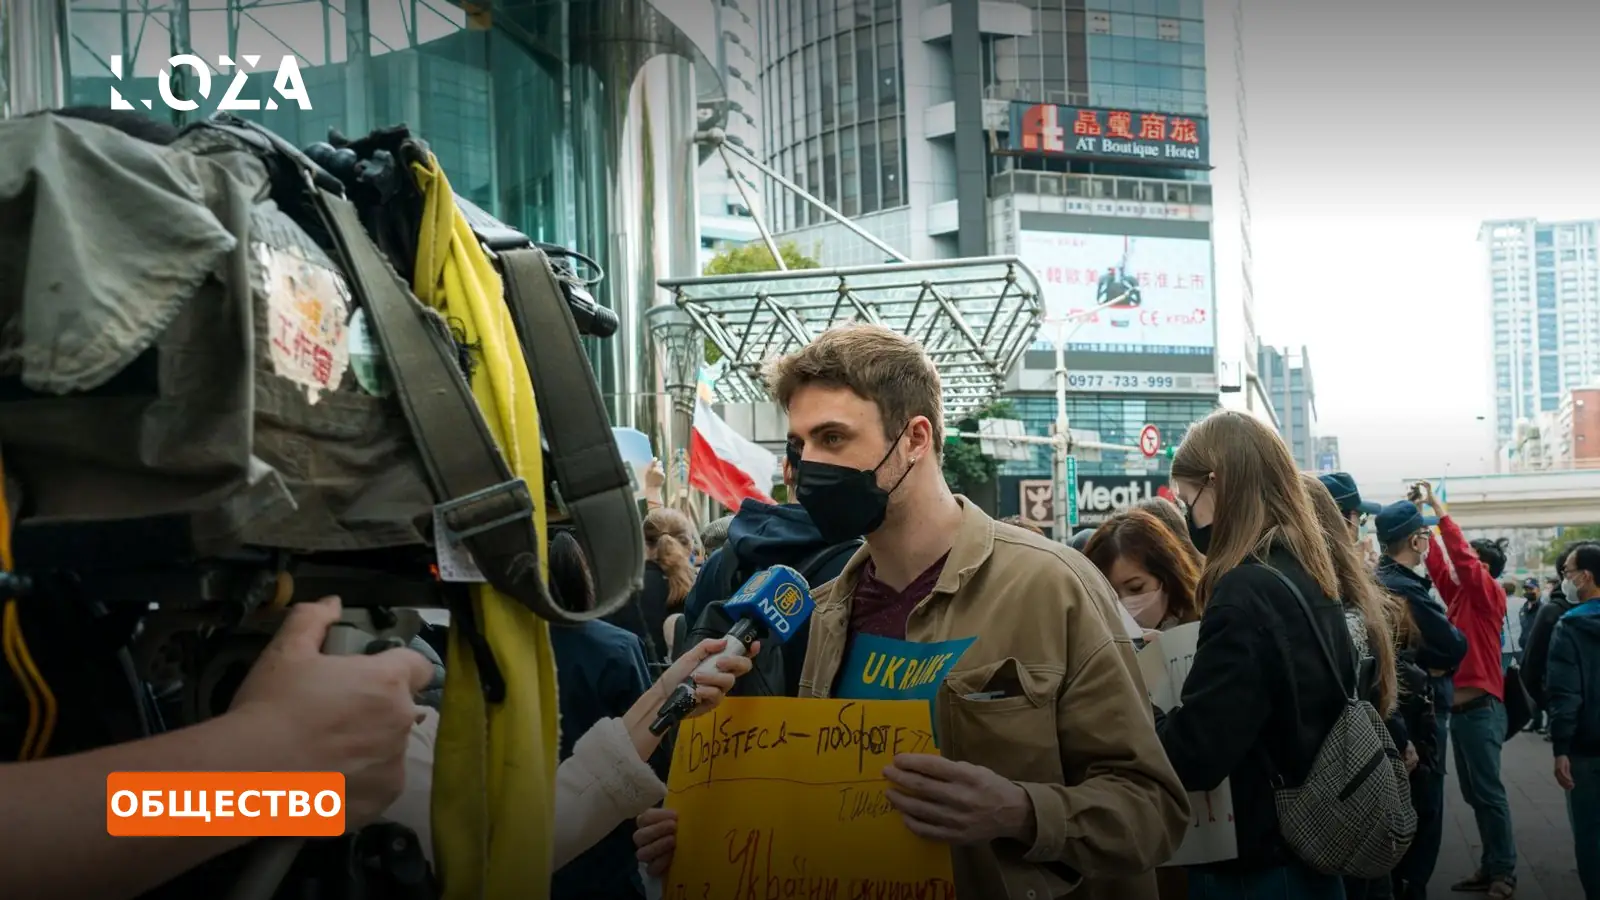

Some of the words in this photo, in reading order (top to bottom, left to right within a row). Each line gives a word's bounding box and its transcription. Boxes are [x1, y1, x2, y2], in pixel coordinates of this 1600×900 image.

[1075, 138, 1096, 151] AT
[1102, 138, 1159, 158] Boutique
[1165, 144, 1200, 159] Hotel
[757, 597, 790, 633] NTD
[862, 651, 953, 690] UKRAINE
